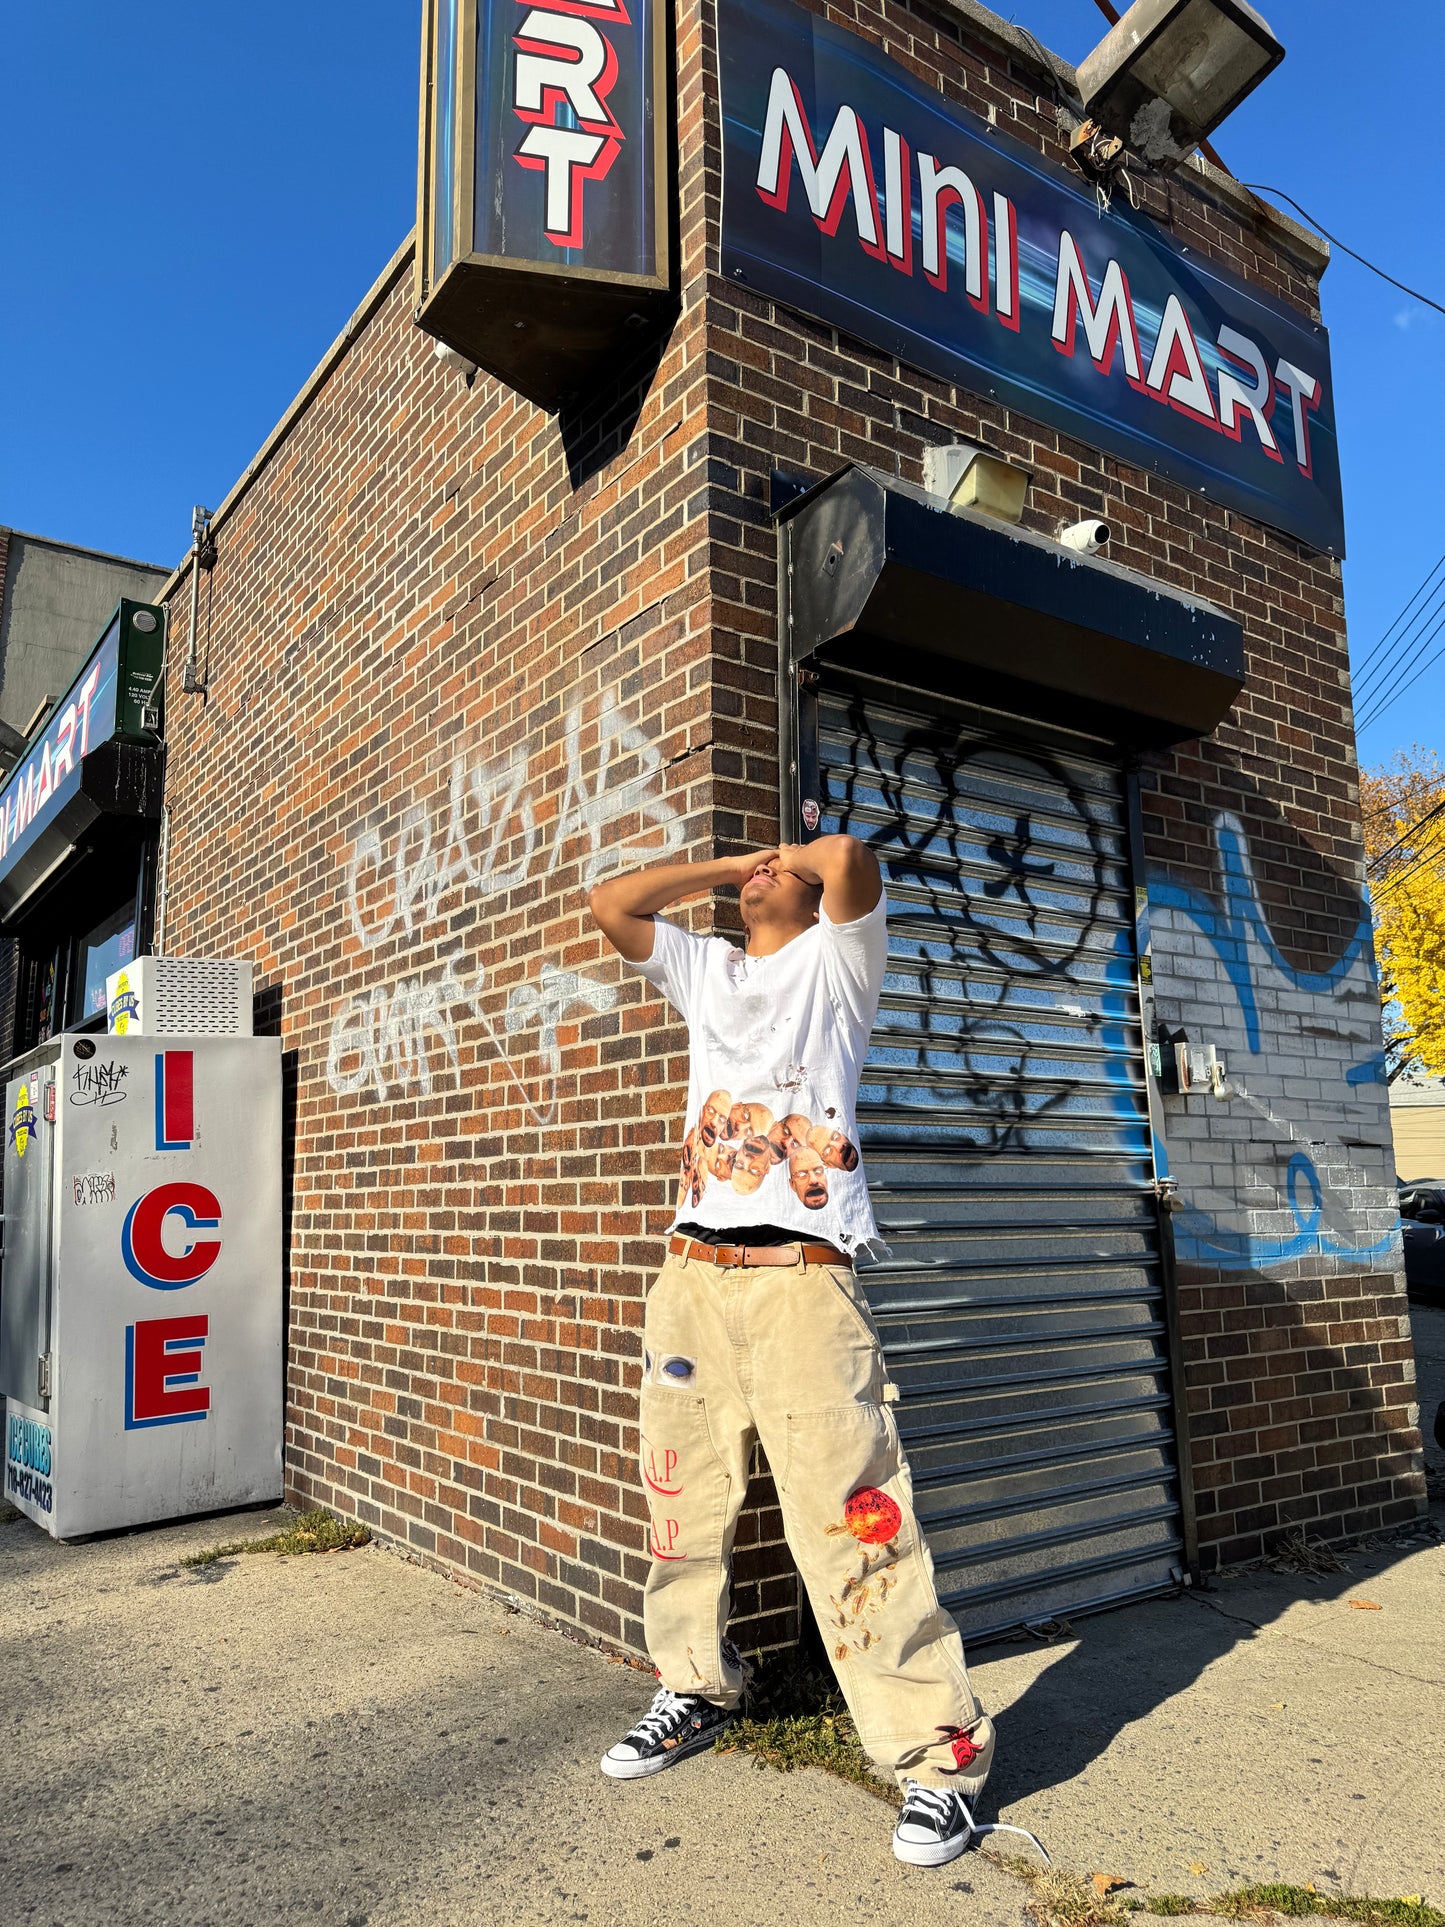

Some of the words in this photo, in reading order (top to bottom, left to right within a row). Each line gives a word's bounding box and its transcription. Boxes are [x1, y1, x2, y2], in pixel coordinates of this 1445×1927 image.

[1051, 229, 1322, 480] MART
[12, 661, 100, 845] MART
[122, 1050, 223, 1431] ICE
[9, 1414, 22, 1464] ICE
[22, 1418, 52, 1478] CUBES
